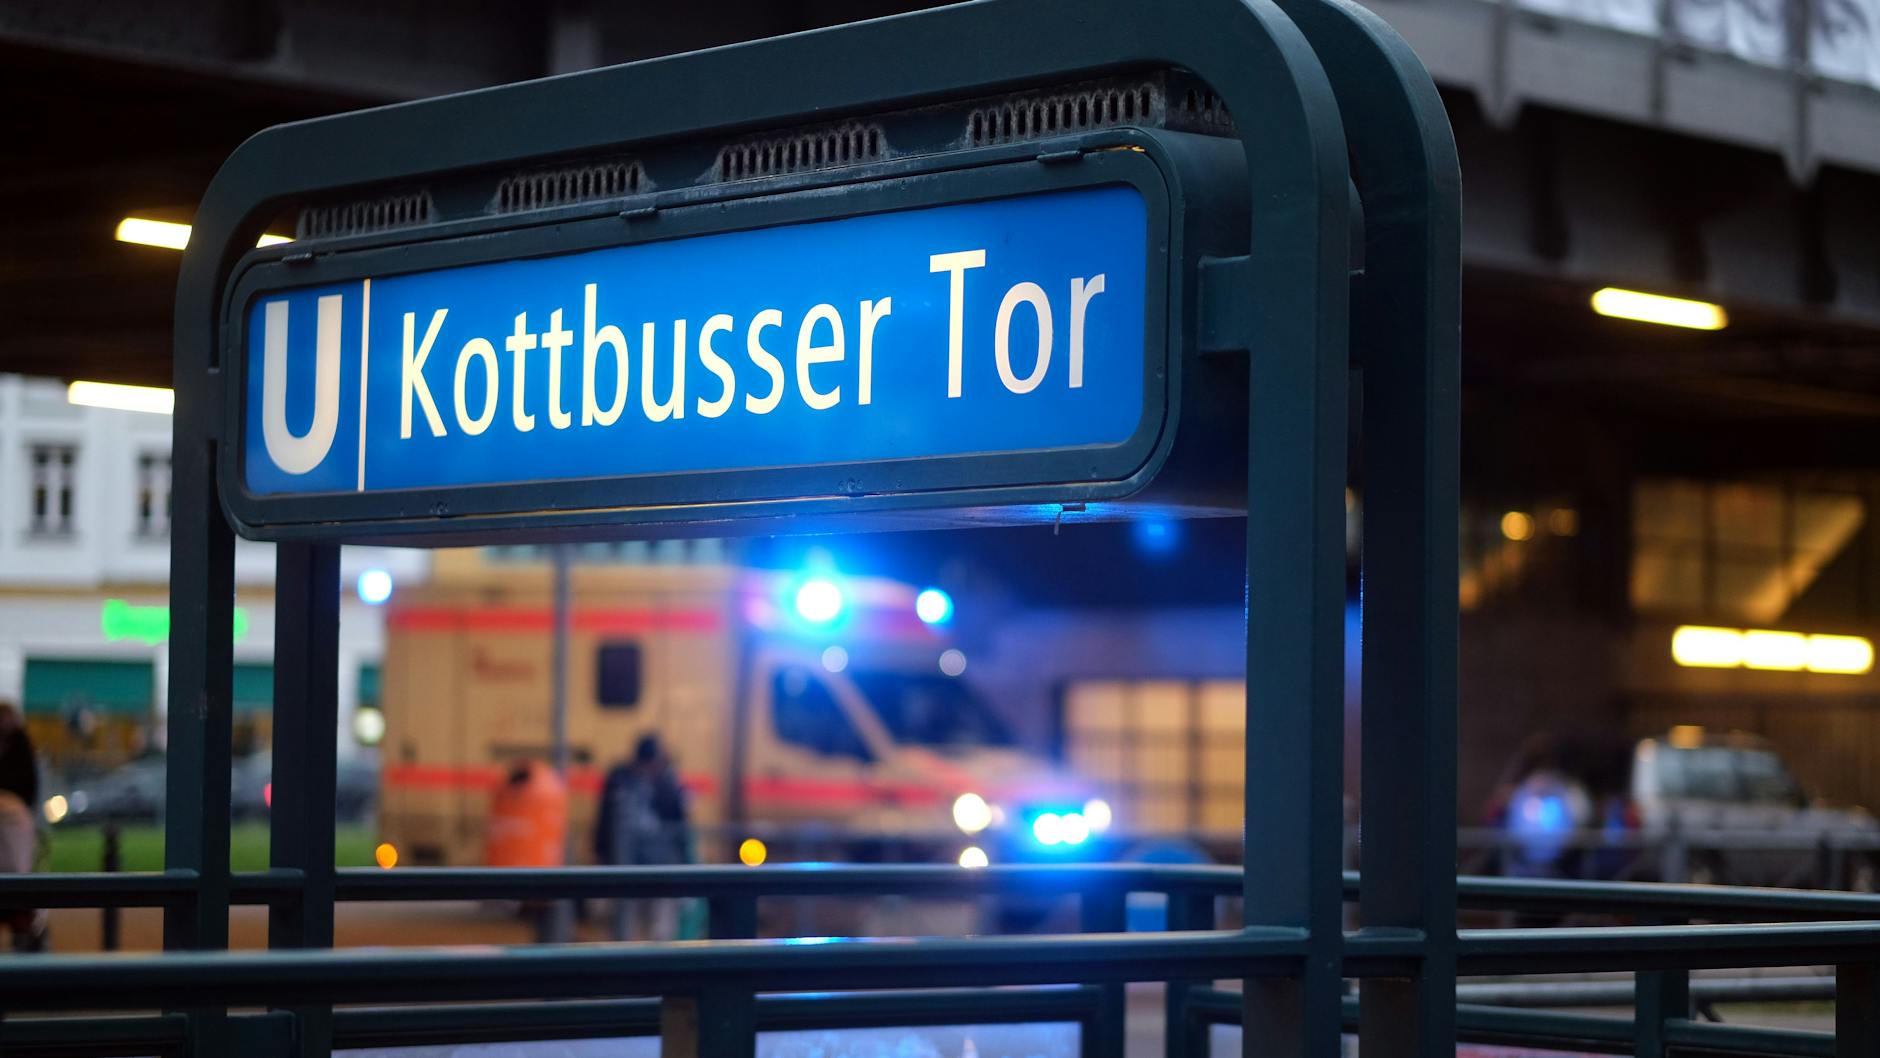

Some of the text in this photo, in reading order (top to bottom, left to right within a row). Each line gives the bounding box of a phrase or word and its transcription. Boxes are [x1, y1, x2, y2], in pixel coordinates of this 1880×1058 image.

[262, 295, 343, 475] U
[399, 249, 1106, 440] Kottbusser Tor
